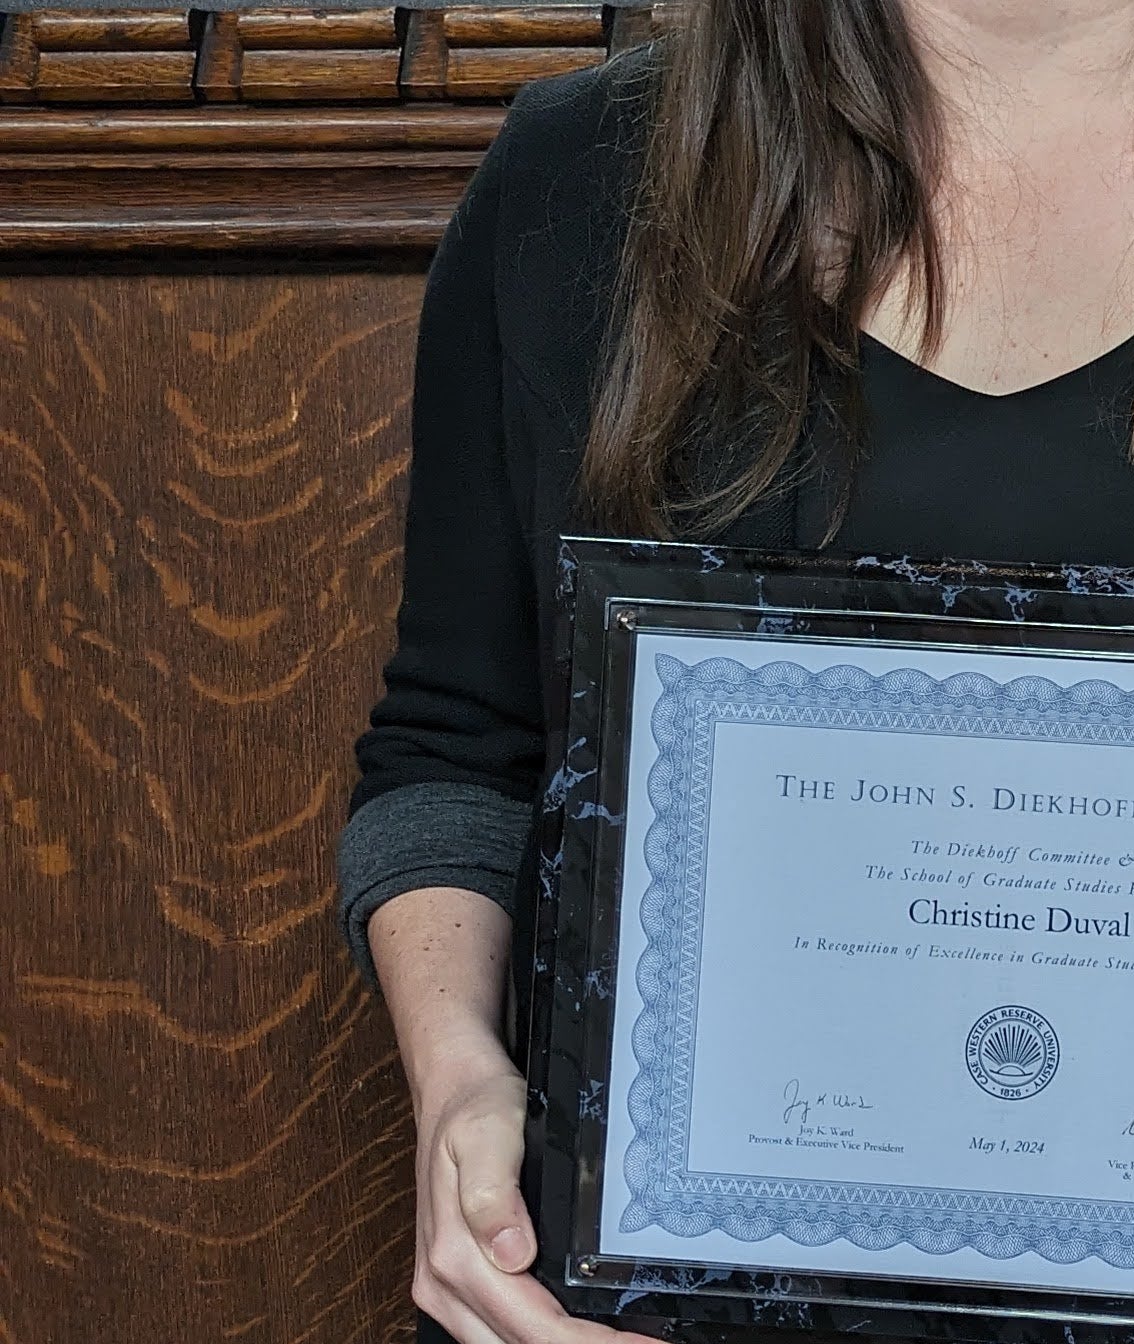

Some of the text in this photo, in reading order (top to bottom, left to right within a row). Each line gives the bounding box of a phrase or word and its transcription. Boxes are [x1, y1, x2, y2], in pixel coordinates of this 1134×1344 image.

[776, 774, 835, 801] THE
[850, 779, 936, 806] JOHN
[951, 785, 975, 809] S.
[911, 840, 940, 856] The
[947, 841, 1020, 863] Diekhoff
[1028, 847, 1111, 866] Committee
[865, 865, 894, 881] The
[900, 866, 952, 885] School
[957, 871, 974, 888] of
[983, 872, 1057, 891] Graduate
[1065, 877, 1122, 895] Studies
[908, 898, 1130, 937] Christine Duval
[794, 937, 809, 950] In
[817, 937, 898, 957] Recognition
[905, 944, 921, 959] of
[928, 945, 1004, 962] Excellence
[1010, 950, 1024, 963] in
[1031, 952, 1100, 969] Graduate
[969, 1009, 1056, 1089] CASE WESTERN RESERVE UNIVERSITY
[1001, 1088, 1021, 1097] 1826
[799, 1125, 813, 1136] Joy
[830, 1128, 854, 1136] Ward
[749, 1134, 782, 1144] Provost
[796, 1138, 839, 1148] Executive
[841, 1140, 861, 1150] Vice
[863, 1142, 904, 1153] President
[969, 1137, 1045, 1155] May 1, 2024
[1108, 1160, 1127, 1169] Vice
[1123, 1172, 1132, 1180] &
